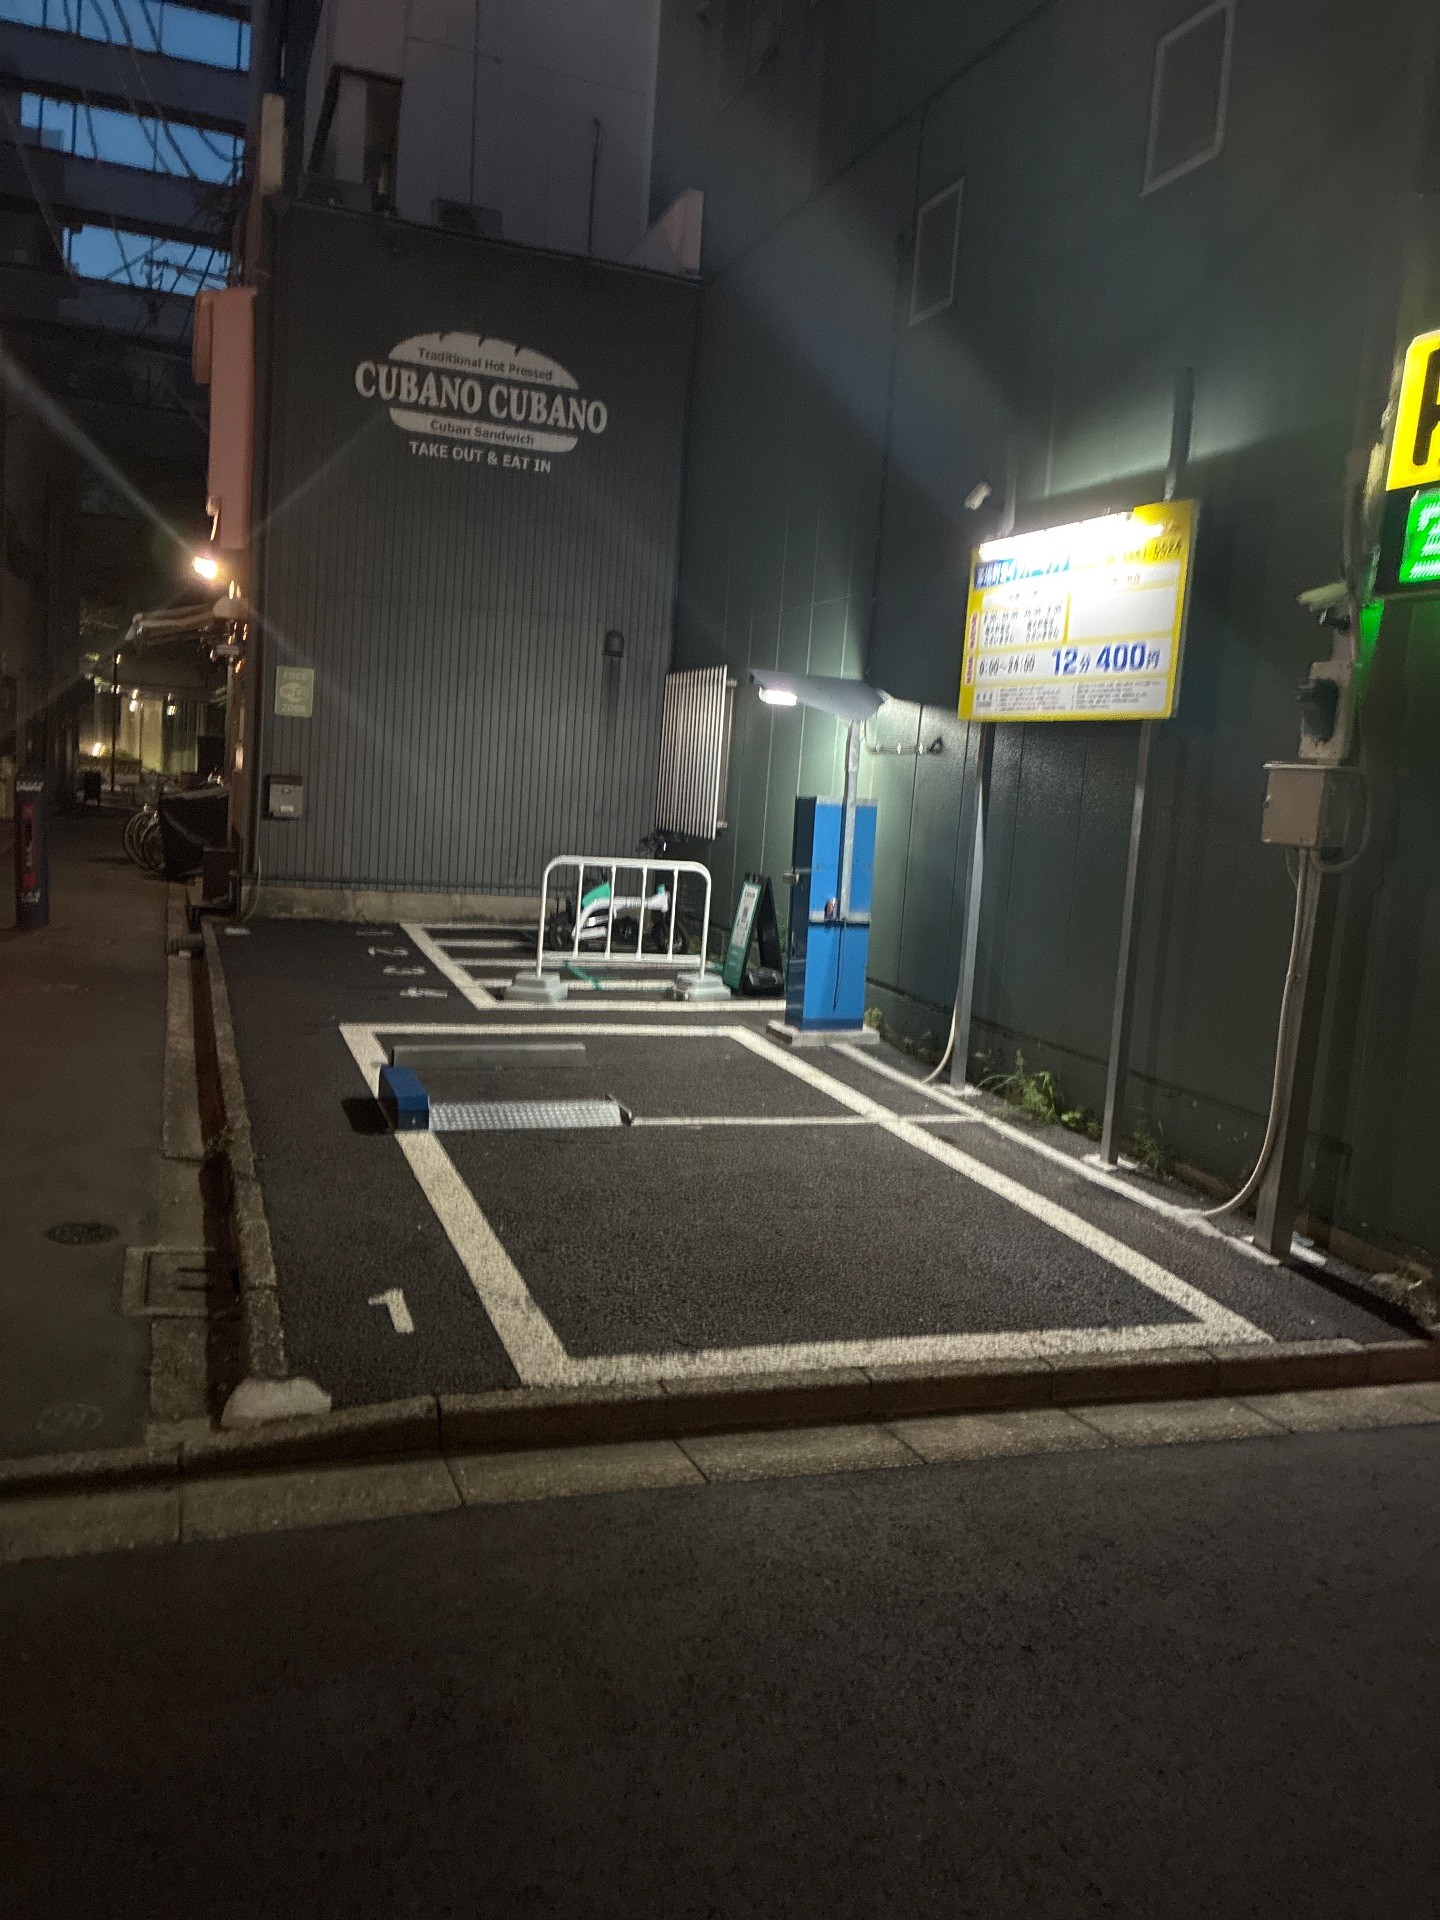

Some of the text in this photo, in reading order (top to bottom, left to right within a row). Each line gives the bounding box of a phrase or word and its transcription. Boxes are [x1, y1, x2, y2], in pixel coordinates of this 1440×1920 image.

[417, 346, 553, 382] Traditional Hot Pressed
[354, 360, 608, 434] CUBANO CUBANO
[430, 419, 535, 446] Cuban Sandwich
[409, 441, 551, 474] TAKE OUT & EAT IN
[368, 1287, 415, 1334] 1
